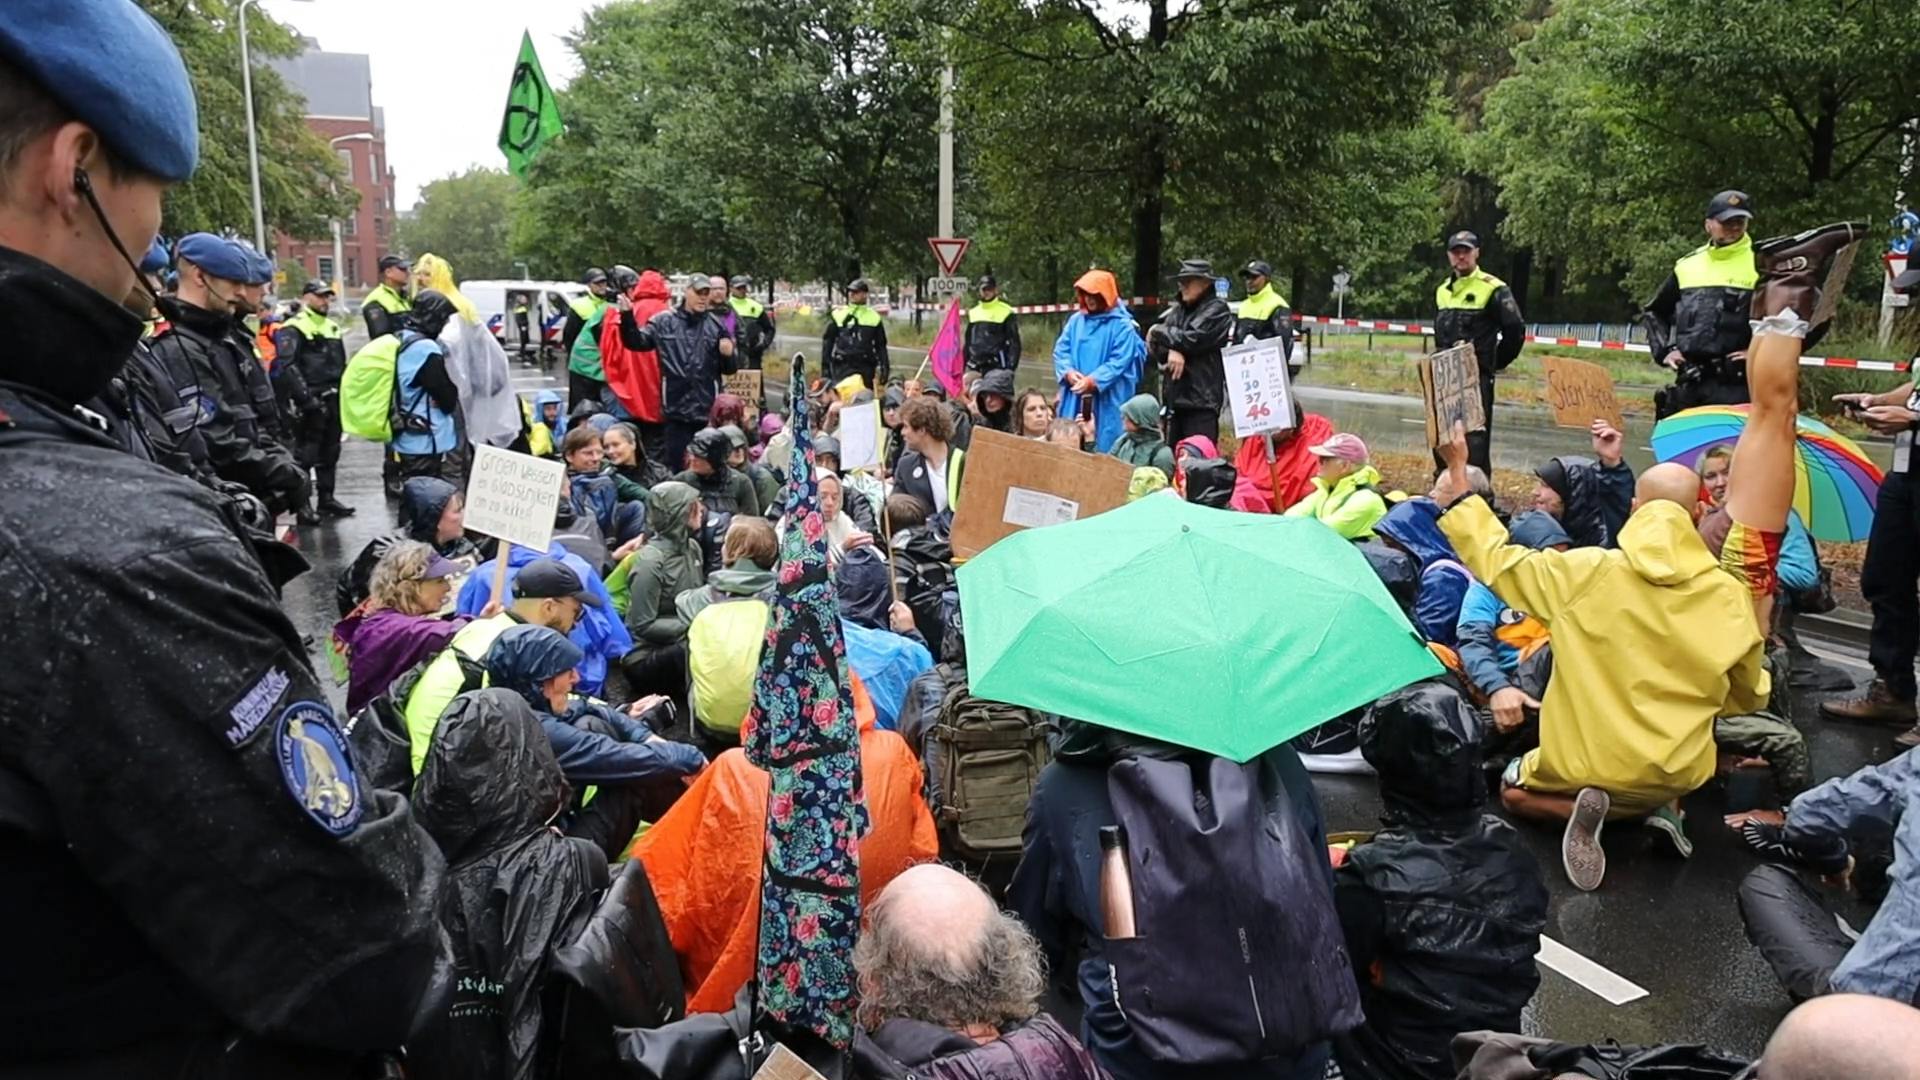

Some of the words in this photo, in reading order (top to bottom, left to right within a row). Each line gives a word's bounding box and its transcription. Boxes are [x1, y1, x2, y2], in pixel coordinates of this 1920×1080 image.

[932, 279, 967, 291] 100m
[1243, 380, 1260, 391] 30
[1245, 392, 1262, 405] 37
[1245, 402, 1271, 421] 46
